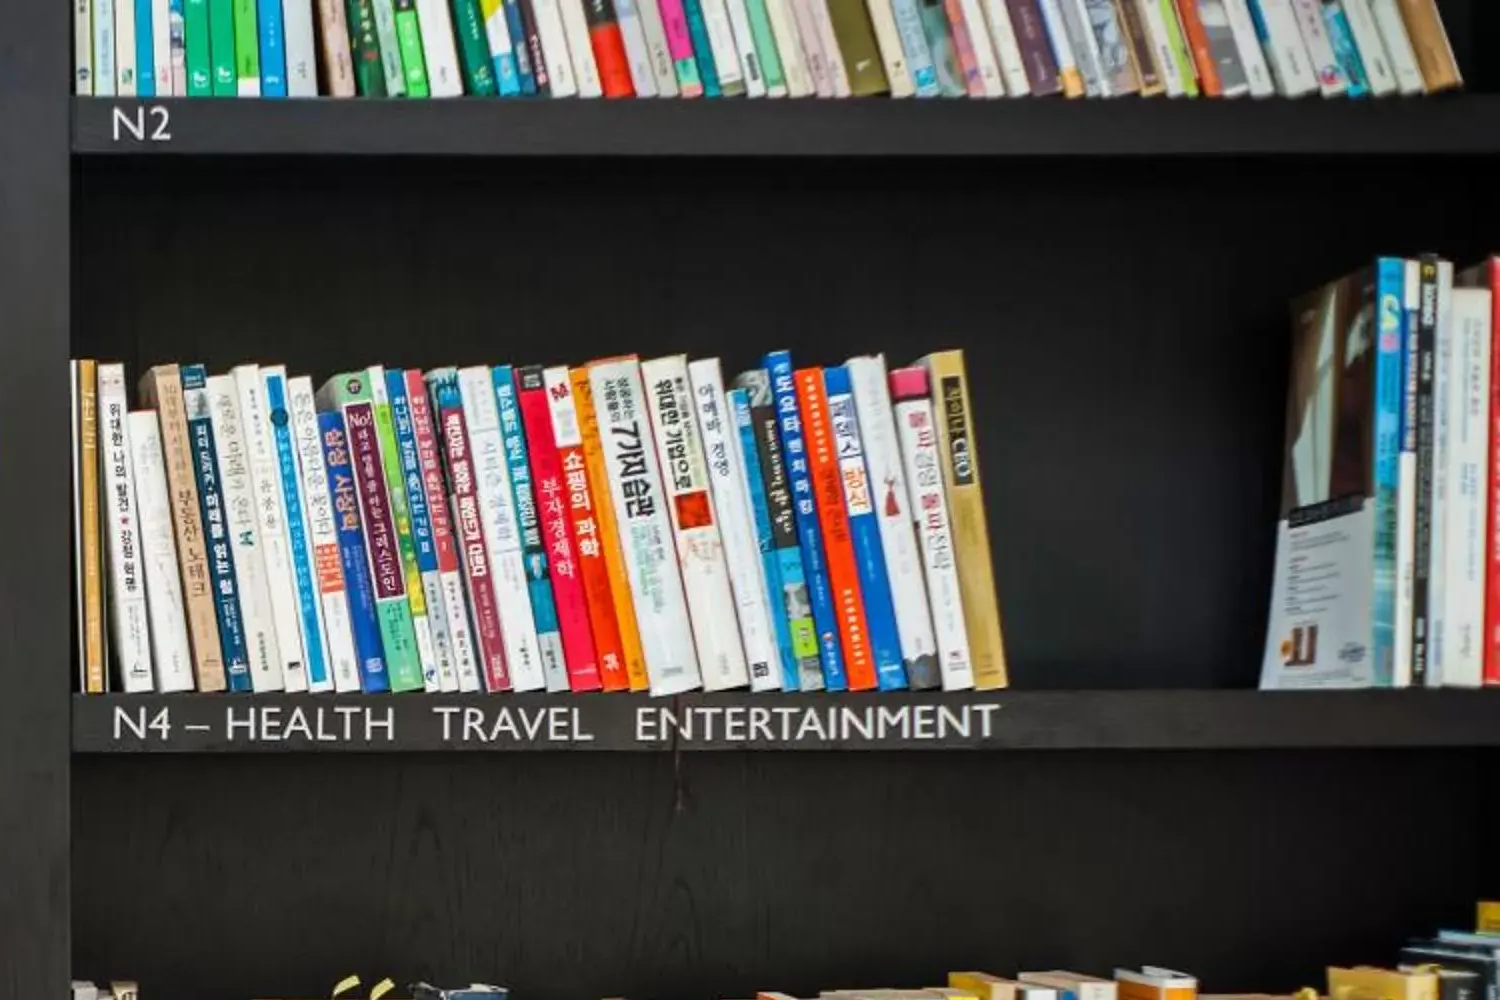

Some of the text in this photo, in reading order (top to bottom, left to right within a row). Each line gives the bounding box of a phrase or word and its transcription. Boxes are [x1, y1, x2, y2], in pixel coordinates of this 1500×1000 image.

[112, 106, 171, 140] N2
[113, 704, 1001, 741] N4 HEALTH TRAVEL ENTERTAINMENT
